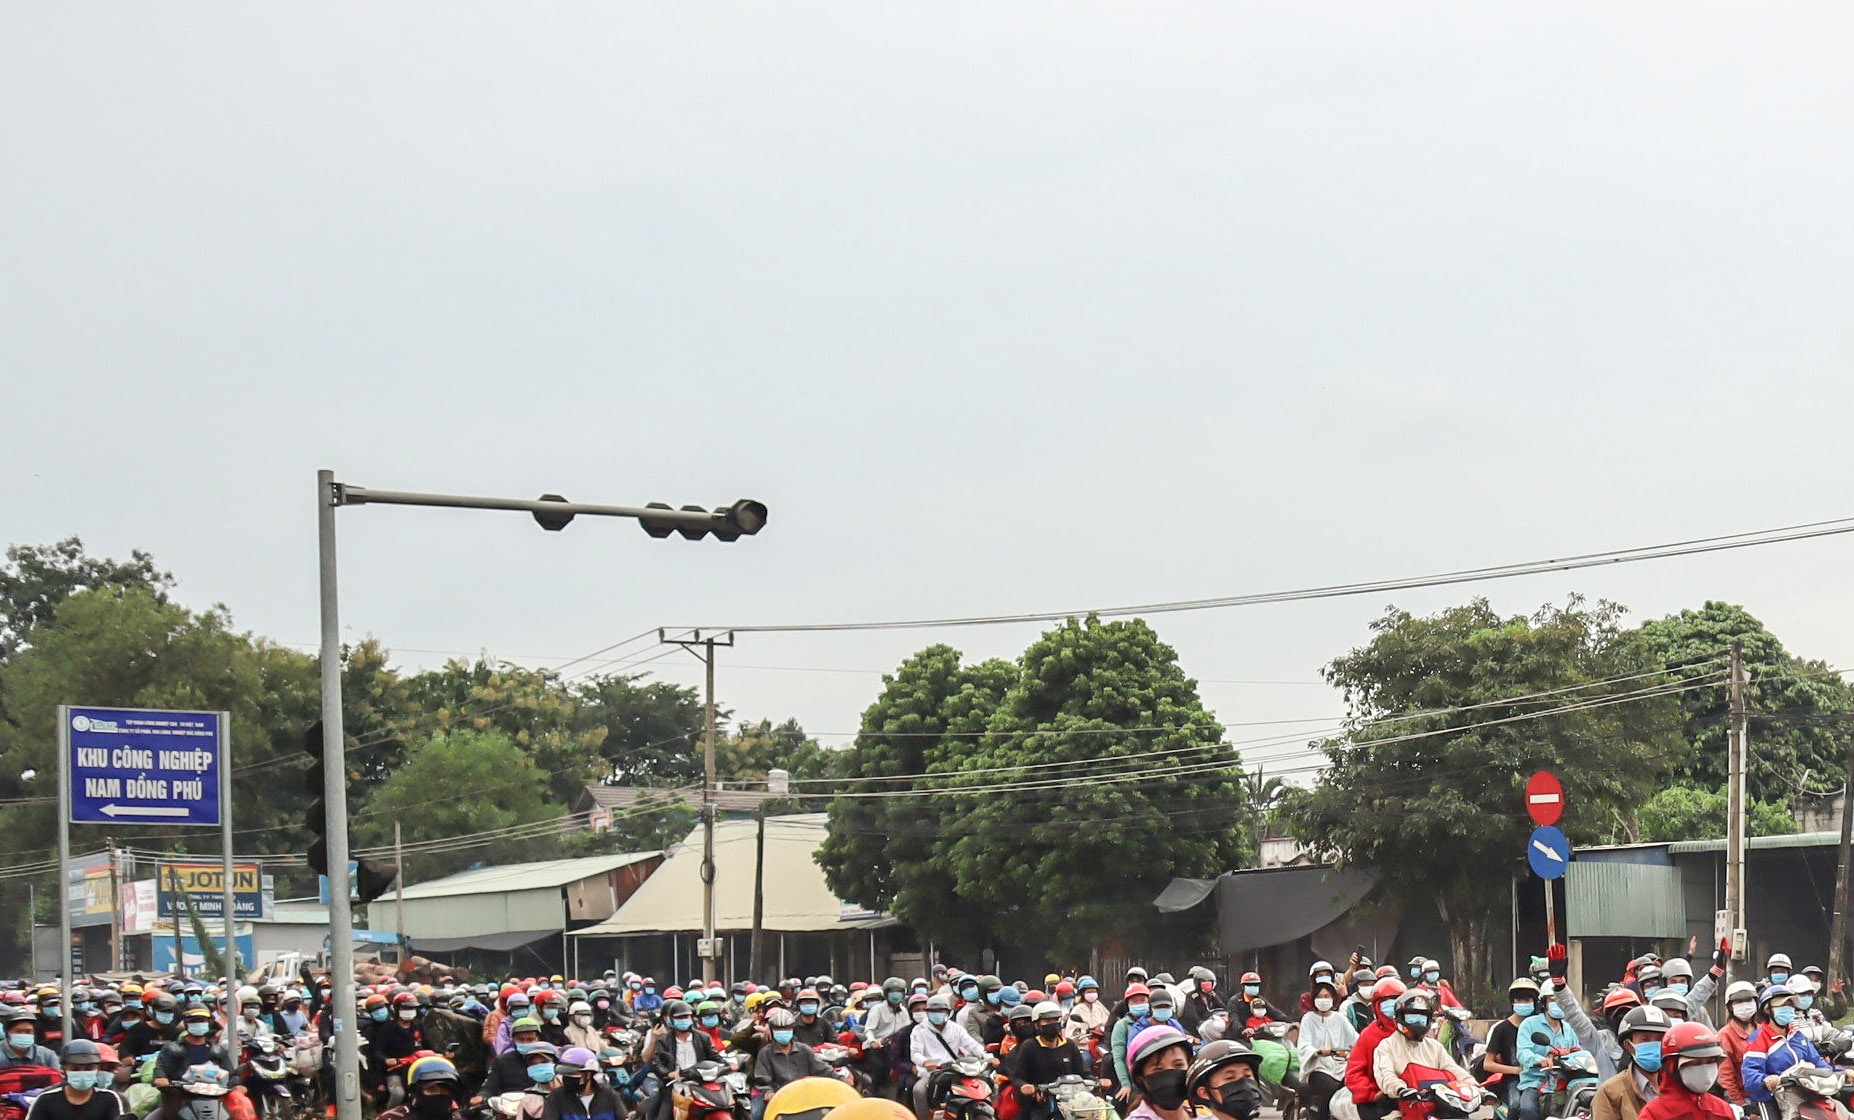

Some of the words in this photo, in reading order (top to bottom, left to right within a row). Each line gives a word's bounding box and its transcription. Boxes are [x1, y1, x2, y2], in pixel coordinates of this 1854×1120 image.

[77, 747, 108, 768] KHU
[112, 744, 153, 770] CÔNG
[159, 747, 213, 775] NGHIỆP
[85, 777, 121, 798] NAM
[126, 771, 168, 800] ĐỒNG
[172, 777, 203, 801] PHÚ
[200, 901, 222, 911] MINH
[232, 899, 255, 911] OÀNG
